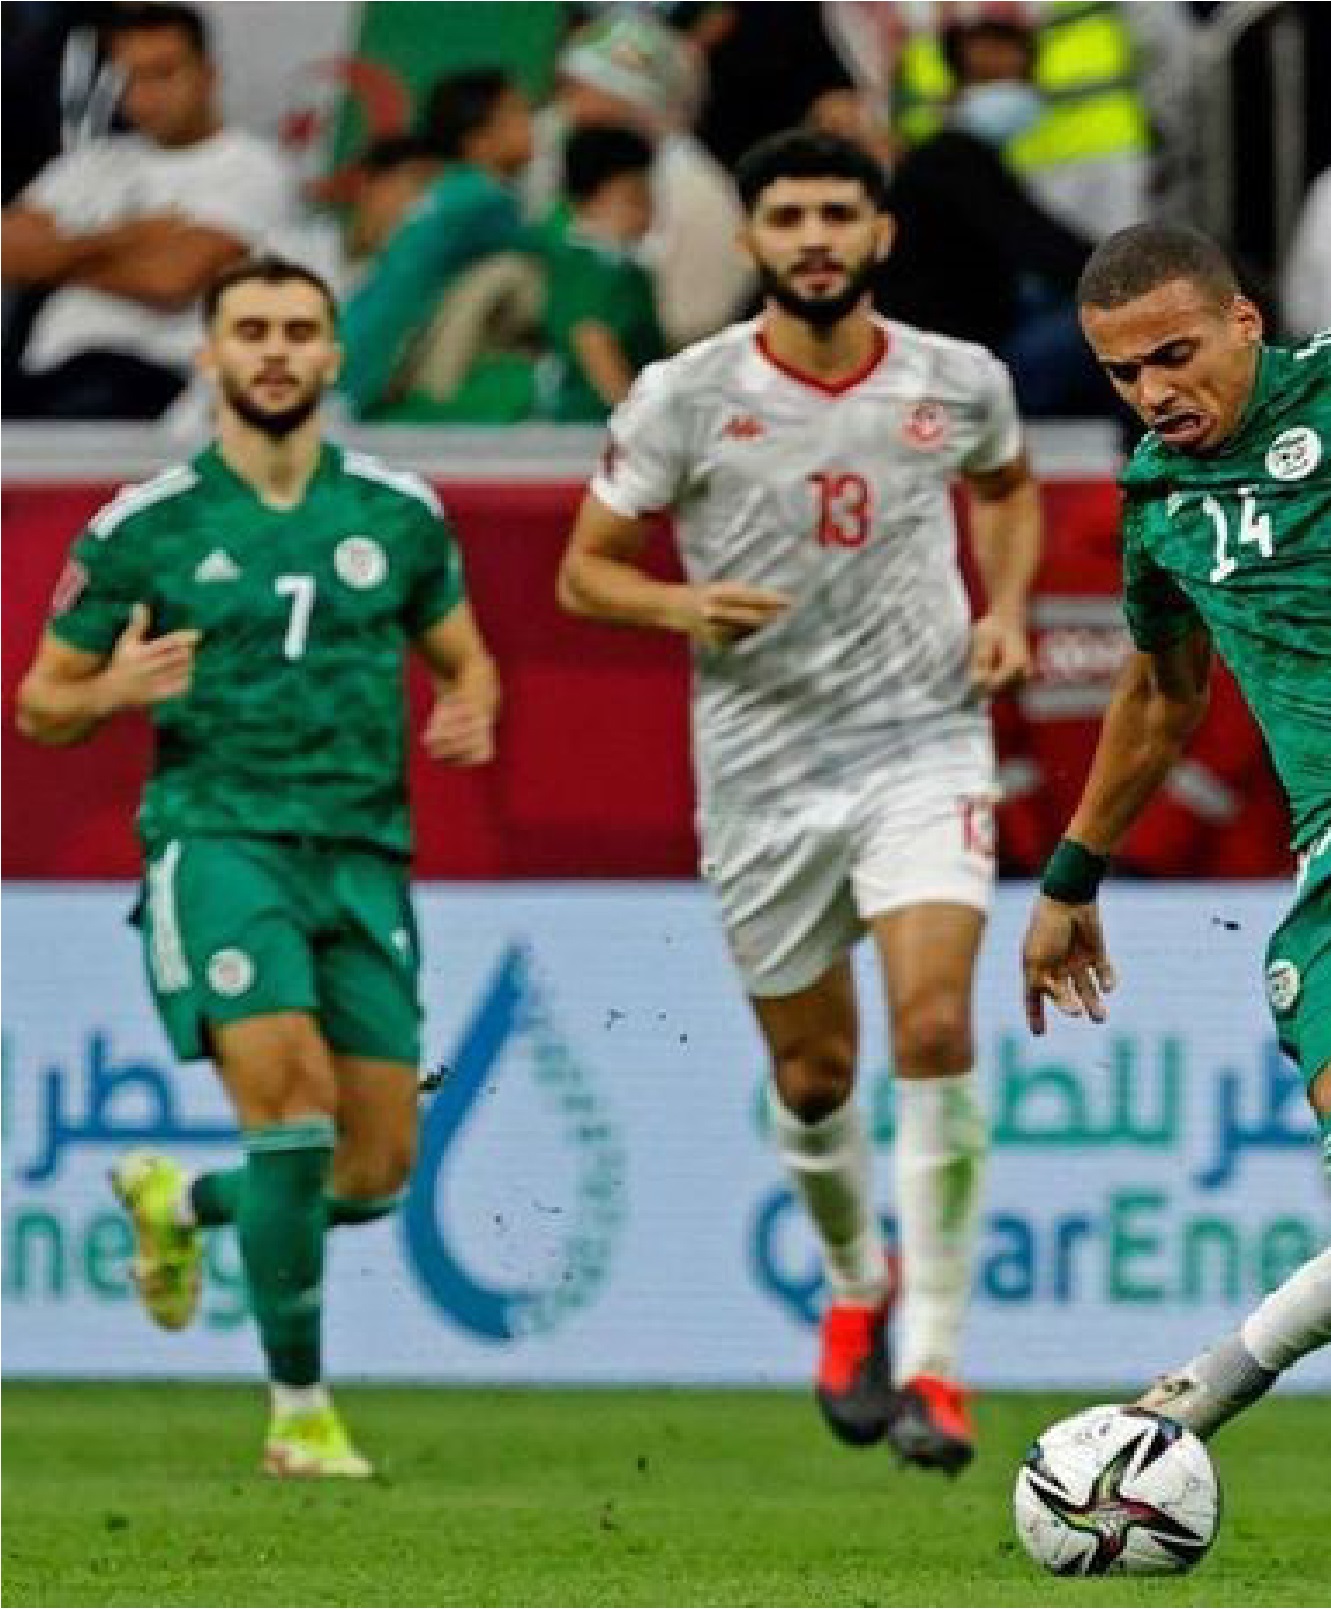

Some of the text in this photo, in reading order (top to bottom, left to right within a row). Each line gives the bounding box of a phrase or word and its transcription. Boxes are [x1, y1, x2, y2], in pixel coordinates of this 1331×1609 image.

[805, 468, 869, 550] 13
[1202, 484, 1274, 583] 14
[274, 575, 316, 661] 7
